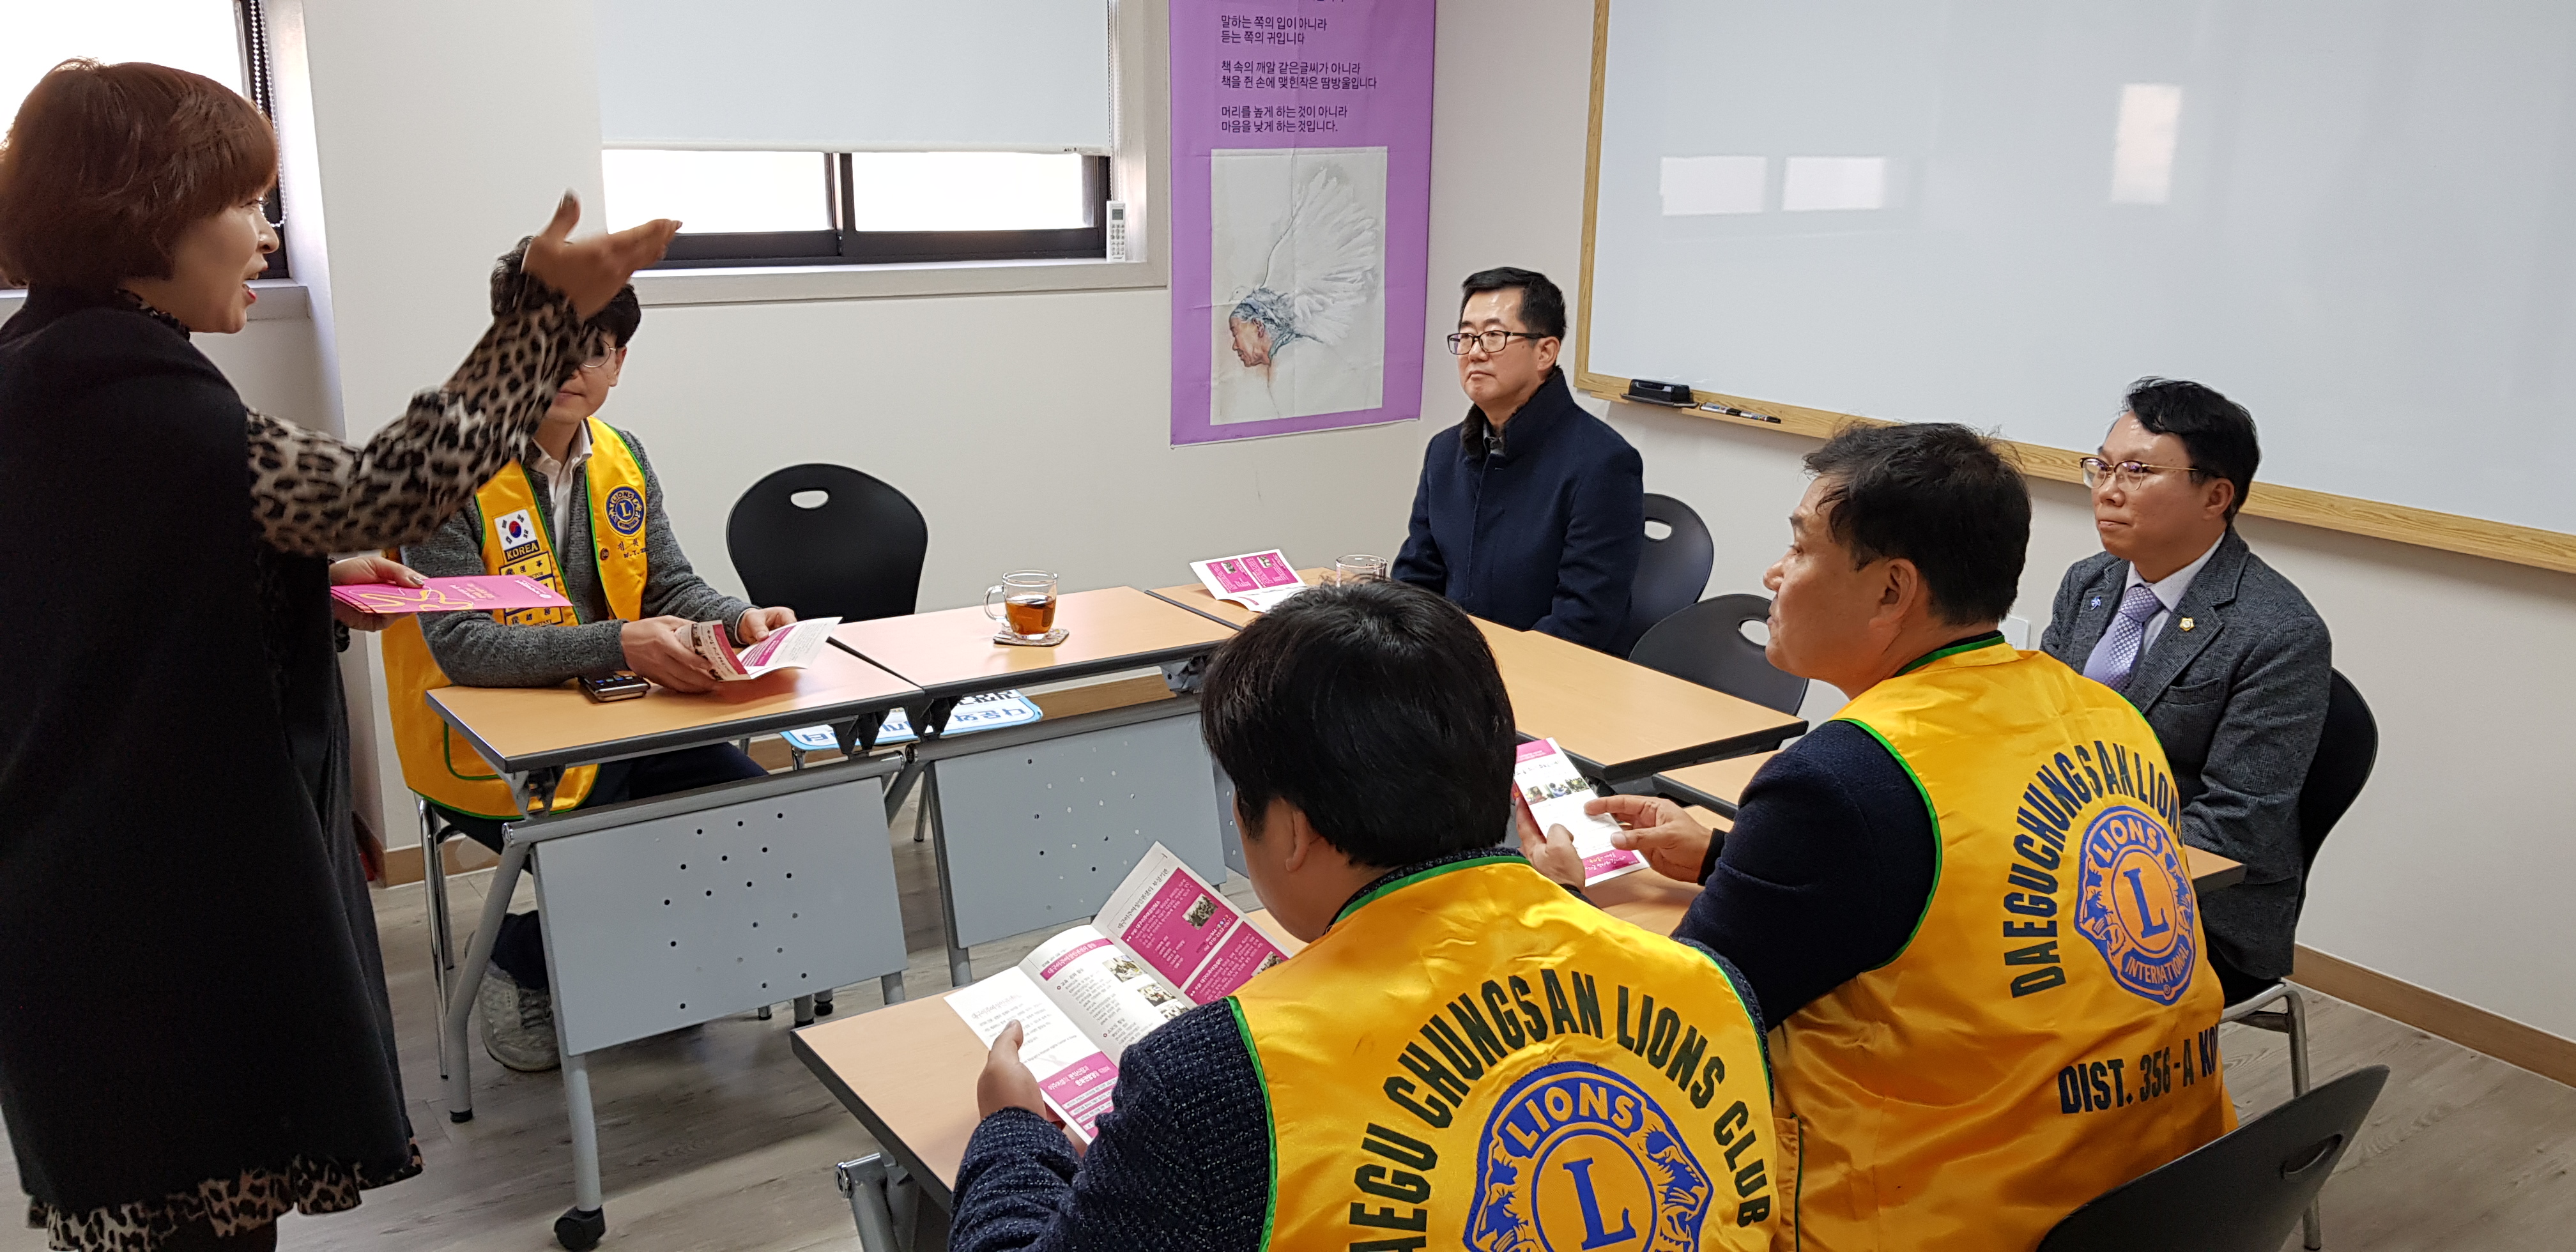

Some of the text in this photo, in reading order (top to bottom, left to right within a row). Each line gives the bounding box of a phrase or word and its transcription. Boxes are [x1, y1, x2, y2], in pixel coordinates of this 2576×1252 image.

[1221, 15, 1328, 31] 말하는 쪽의 입이 아니라
[1220, 30, 1305, 45] 듣는 쪽의 귀입니다
[1221, 60, 1231, 73] 책
[1233, 61, 1254, 74] 속의
[1255, 61, 1276, 75] 깨알
[1331, 62, 1361, 75] 아니라
[1221, 75, 1241, 89] 책을
[1255, 75, 1275, 89] 손에
[1321, 77, 1377, 90] 땀방울입니다
[1222, 105, 1347, 119] 머리를 높게 하는 것이 아니라
[1222, 119, 1252, 134] 마음을
[1254, 119, 1273, 133] 낮게
[1276, 119, 1296, 133] 하는
[613, 491, 632, 502] LIONS
[619, 502, 631, 517] L
[506, 542, 539, 560] KOREA
[2092, 817, 2158, 863] LIONS
[2123, 867, 2170, 939] L
[2125, 943, 2189, 984] INTERNATIONAL
[2057, 1058, 2134, 1115] DIST.
[2198, 1023, 2220, 1078] KO
[1383, 968, 1604, 1129] CHUNGSAN
[1616, 984, 1725, 1110] LIONS
[1712, 1100, 1770, 1228] CLUB
[1505, 1082, 1636, 1151] LIONS
[1562, 1157, 1637, 1251] L
